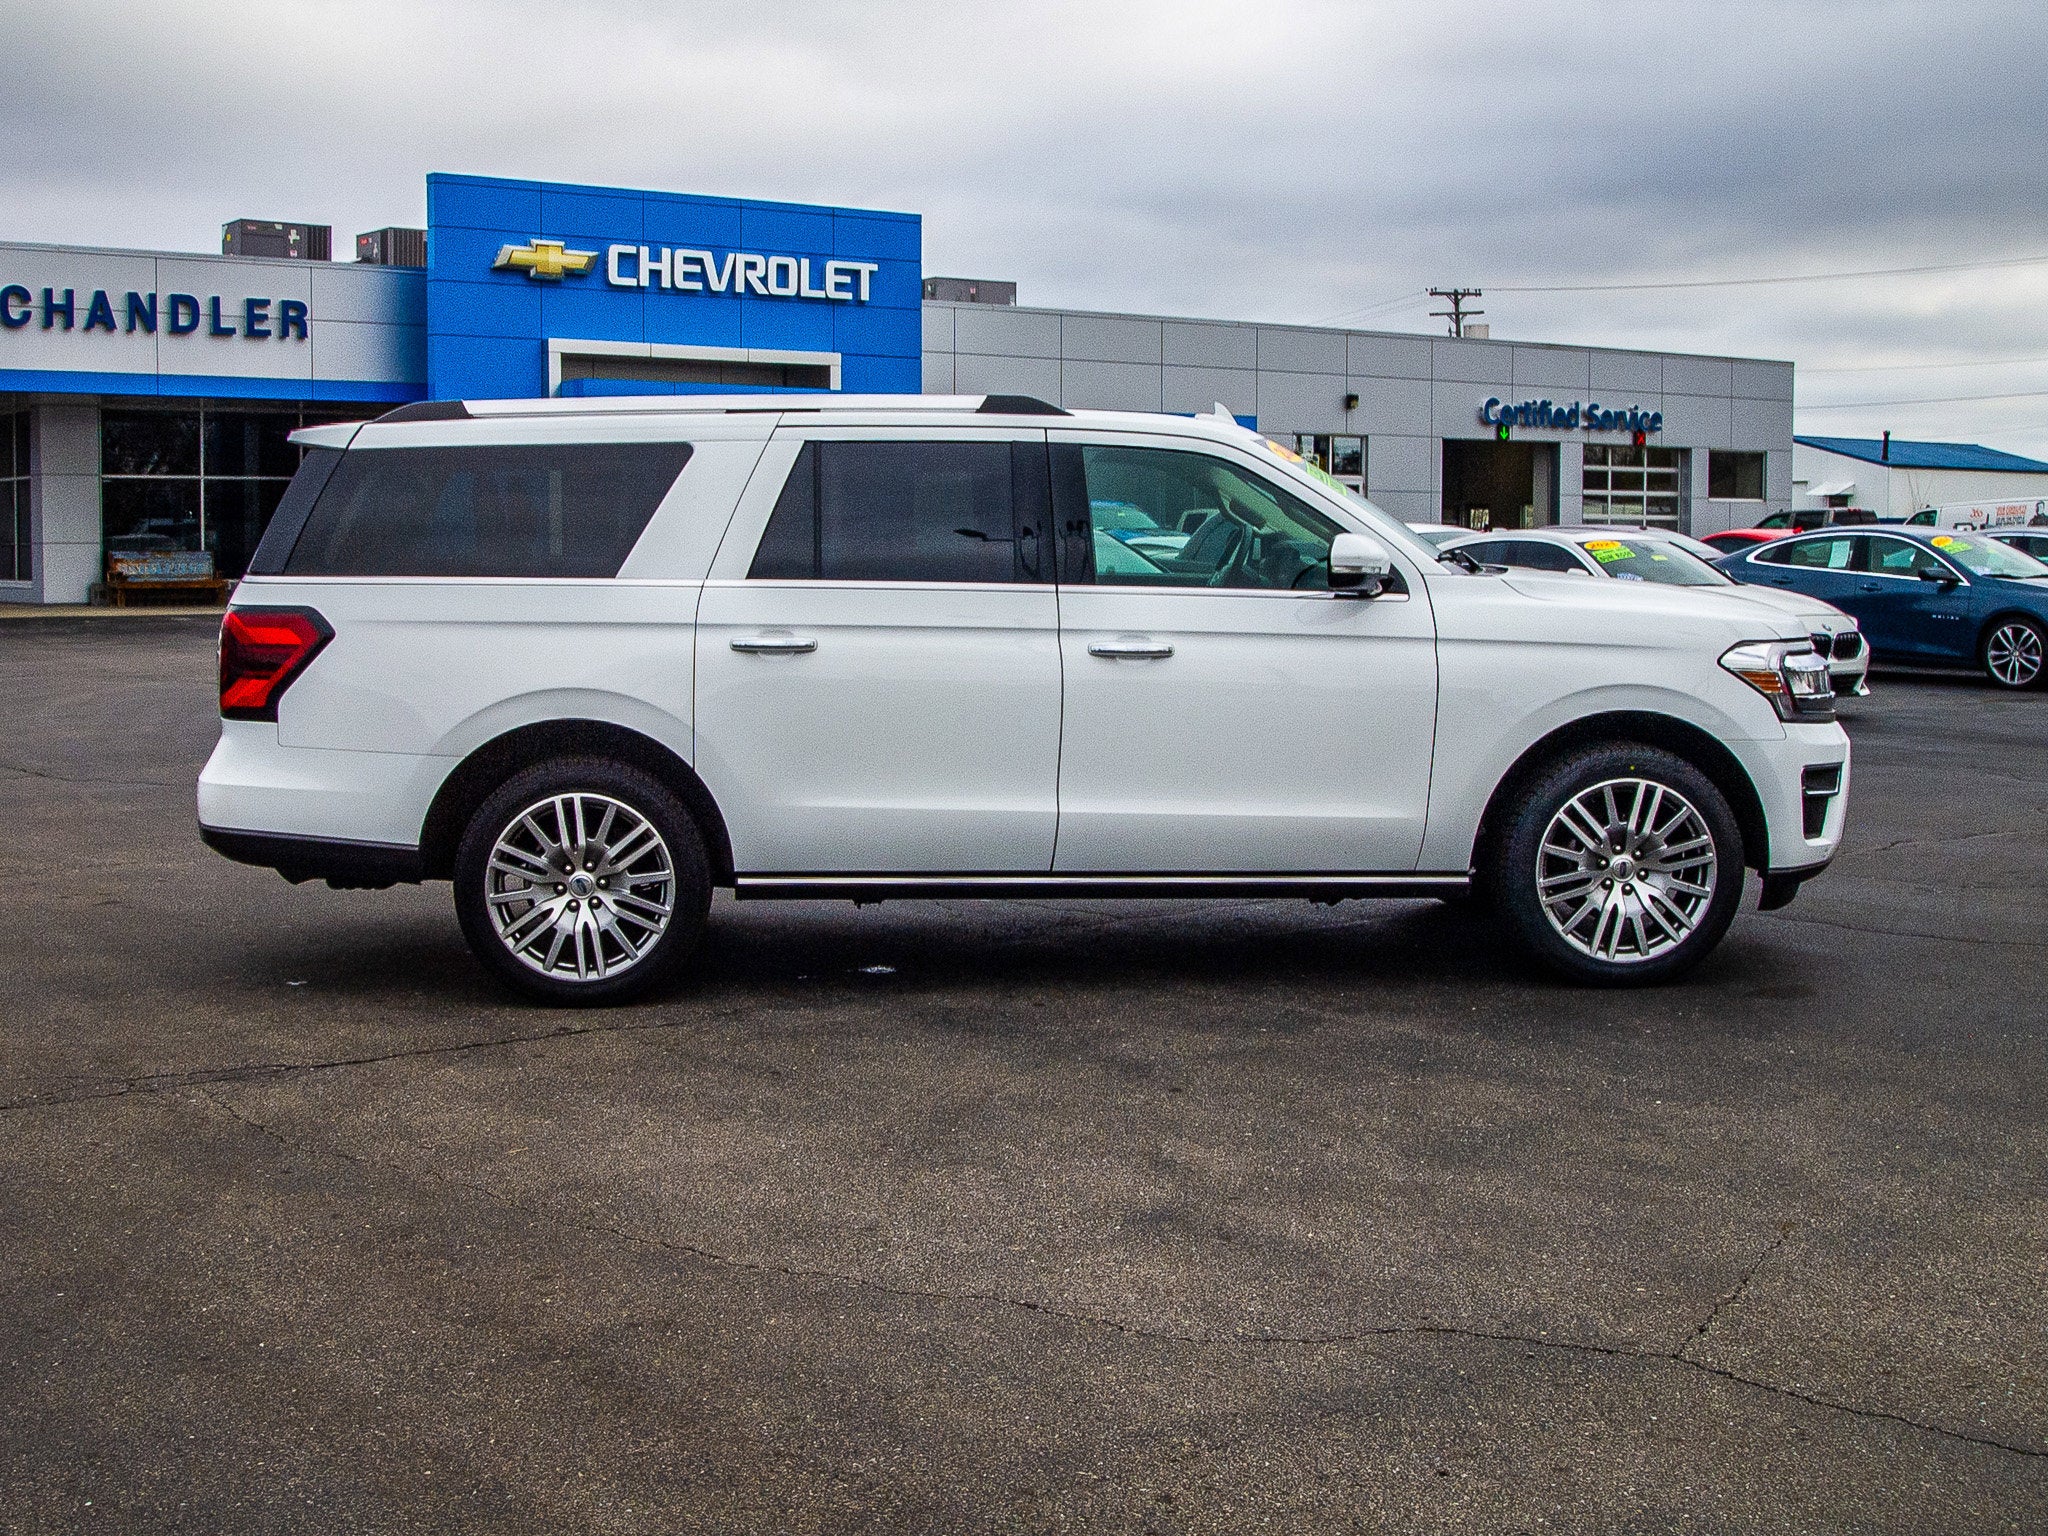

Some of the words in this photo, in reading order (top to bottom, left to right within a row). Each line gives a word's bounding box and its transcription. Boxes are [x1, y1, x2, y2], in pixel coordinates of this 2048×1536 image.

[607, 244, 879, 302] CHEVROLET
[0, 284, 309, 339] CHANDLER
[1483, 397, 1580, 428] Certified
[1587, 403, 1663, 431] Service
